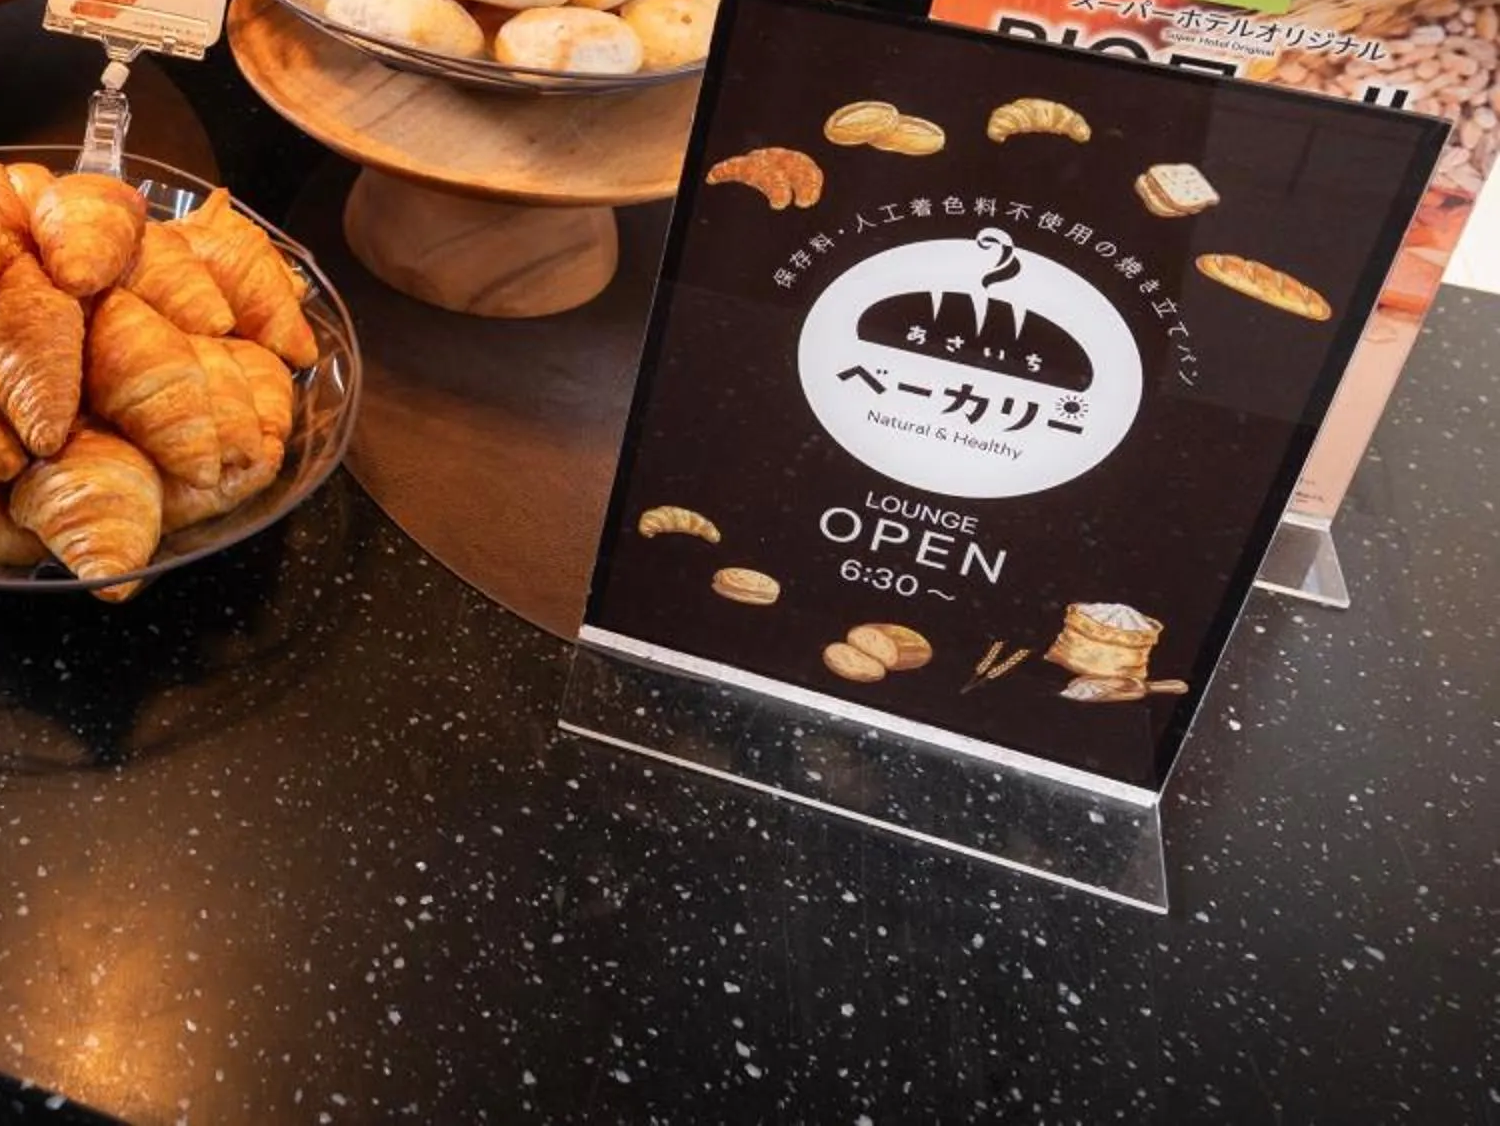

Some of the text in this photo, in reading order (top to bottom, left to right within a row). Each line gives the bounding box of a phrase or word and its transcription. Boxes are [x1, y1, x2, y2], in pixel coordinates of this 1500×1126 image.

[1231, 41, 1276, 57] Original
[772, 196, 1200, 388] 保存料・人工着色料不使用の焼き立てパン
[906, 324, 1044, 374] あさいち
[836, 364, 1085, 436] ベーカリー
[867, 409, 1024, 461] Natural & Healthy
[865, 490, 980, 536] LOUNGE
[818, 506, 1008, 585] OPEN
